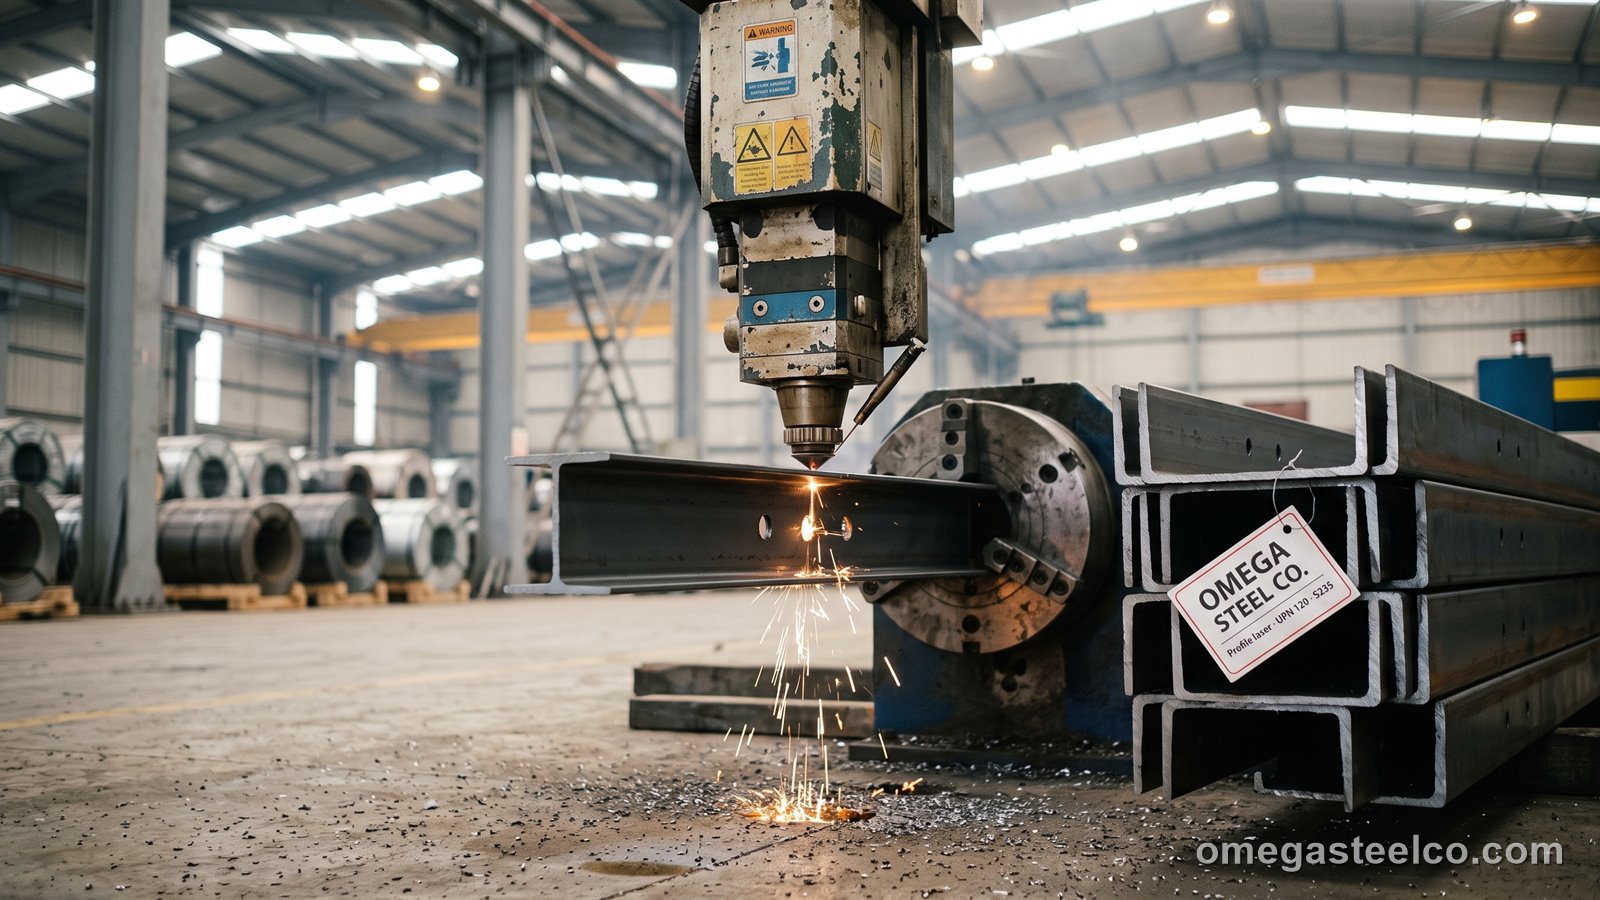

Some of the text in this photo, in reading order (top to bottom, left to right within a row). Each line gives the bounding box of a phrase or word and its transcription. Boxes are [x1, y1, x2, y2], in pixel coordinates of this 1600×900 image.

[759, 25, 793, 36] WARNING
[1199, 541, 1291, 610] OMEGA
[1214, 564, 1309, 633] STEEL CO.
[1226, 581, 1334, 658] Profile laser UPN 120 S235
